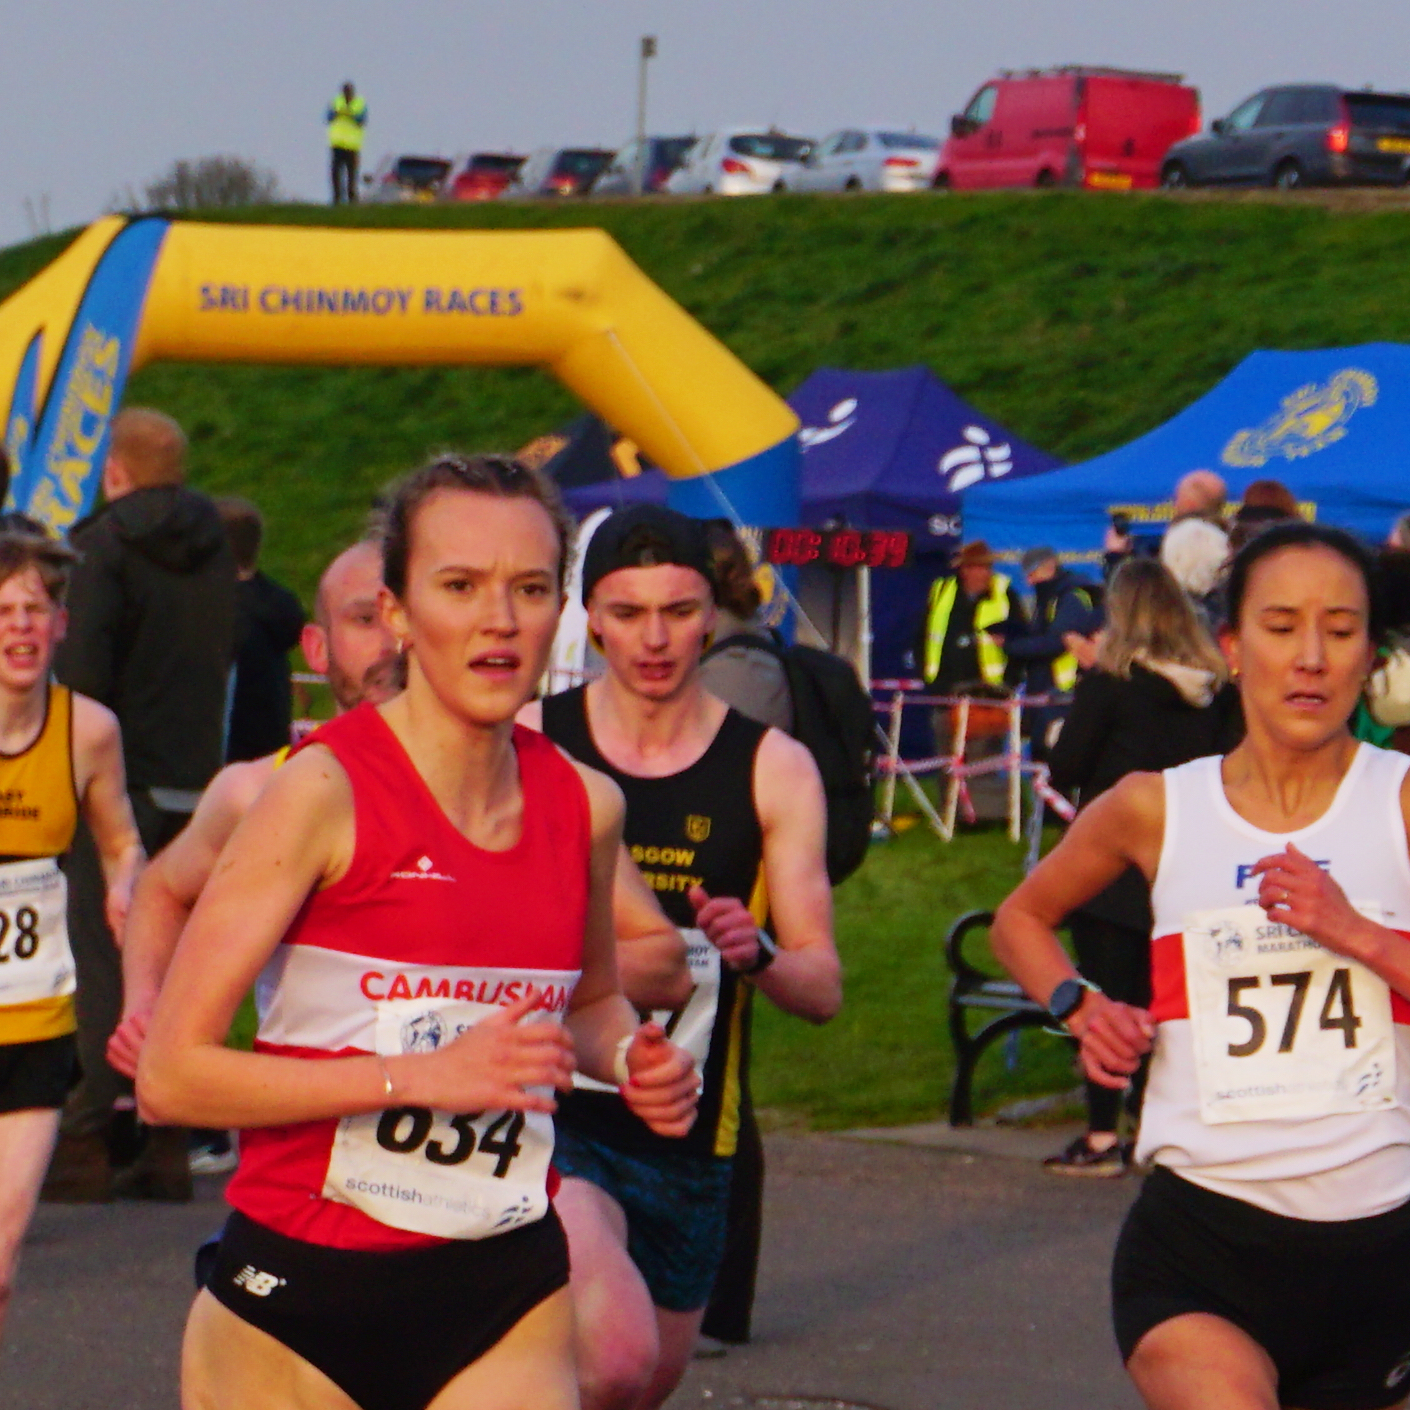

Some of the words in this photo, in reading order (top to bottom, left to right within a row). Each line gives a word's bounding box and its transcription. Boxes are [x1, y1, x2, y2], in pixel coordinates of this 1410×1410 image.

[199, 283, 250, 312] SRI
[260, 284, 413, 315] CHINMOY
[424, 286, 524, 316] RACES
[629, 844, 695, 867] SGOW
[1227, 968, 1362, 1058] 574
